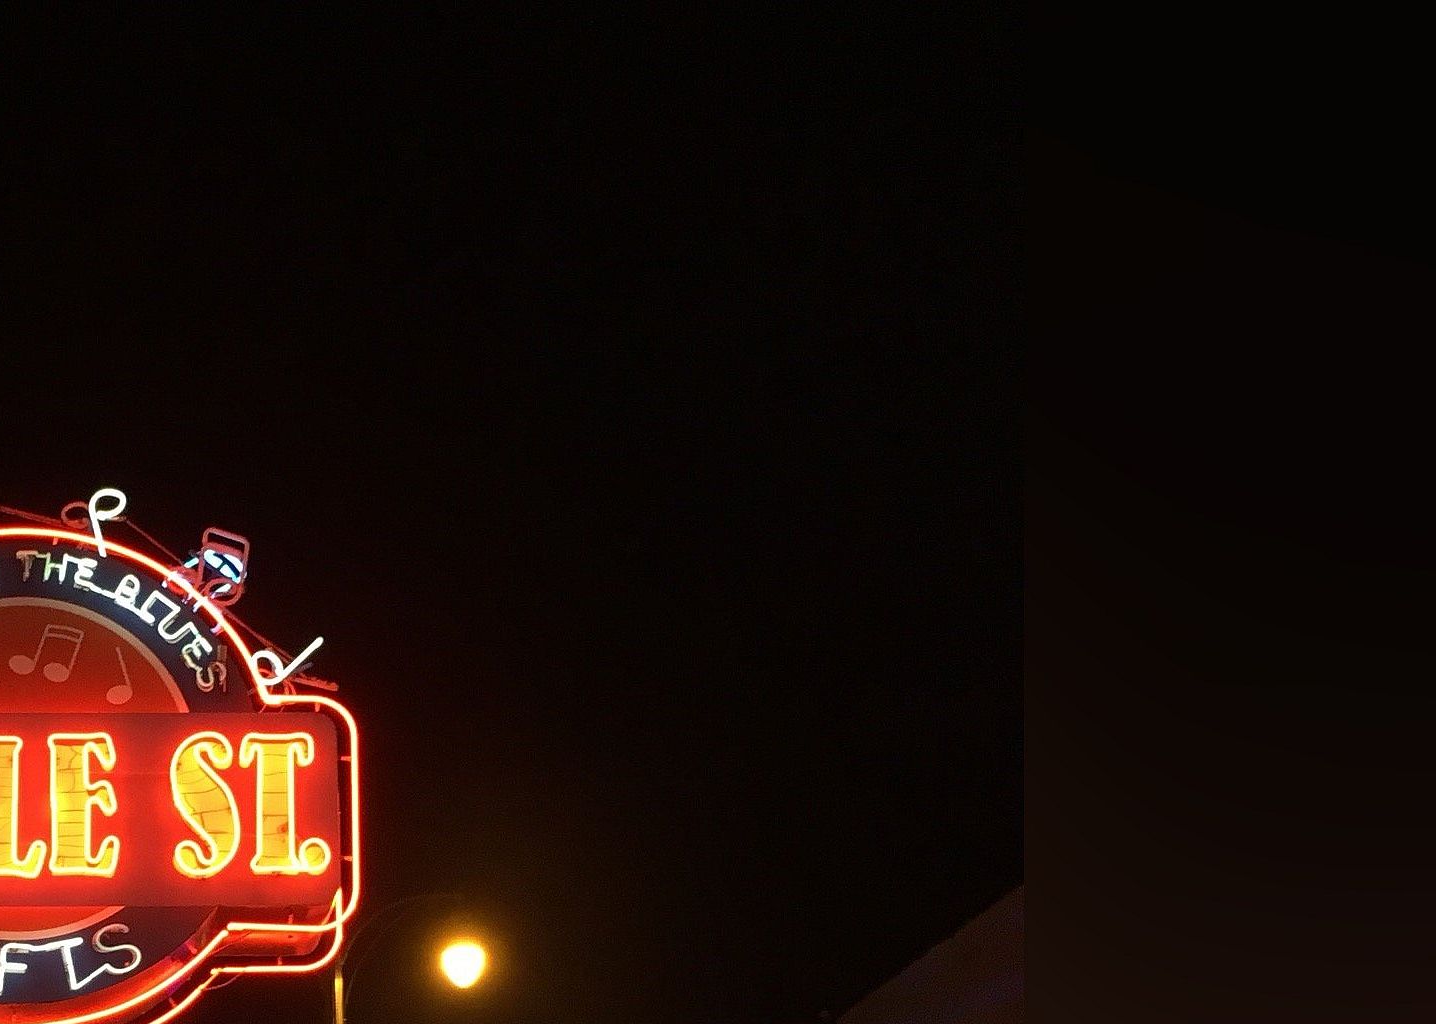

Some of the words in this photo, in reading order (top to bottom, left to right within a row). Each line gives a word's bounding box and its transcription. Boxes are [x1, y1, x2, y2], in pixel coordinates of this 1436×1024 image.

[16, 549, 99, 590] THE
[114, 573, 228, 693] BLUES
[169, 731, 332, 879] ST.
